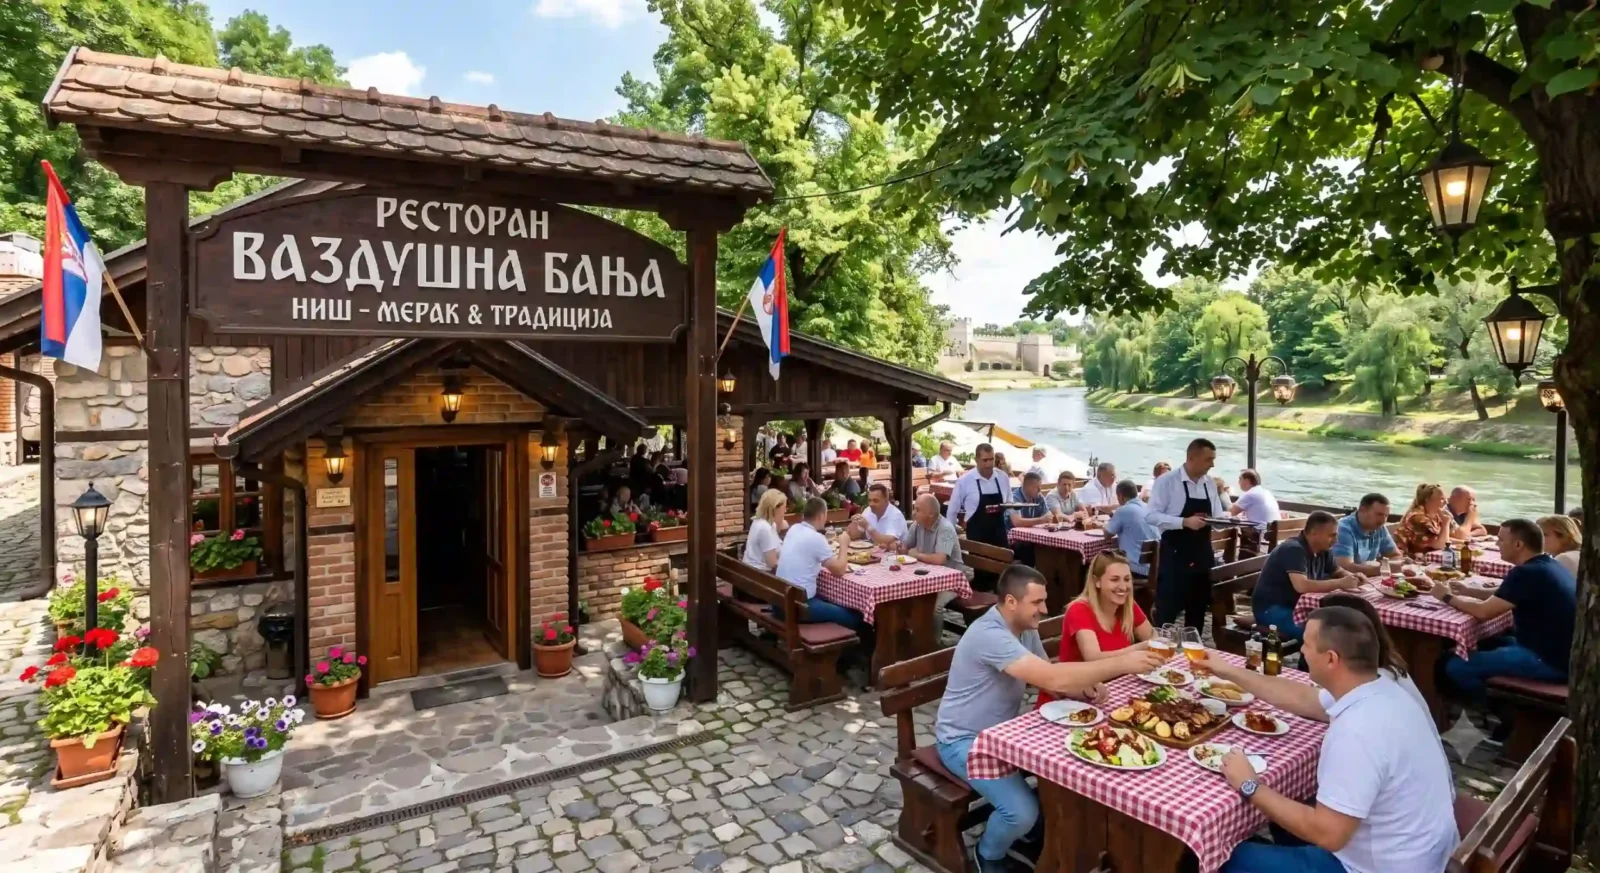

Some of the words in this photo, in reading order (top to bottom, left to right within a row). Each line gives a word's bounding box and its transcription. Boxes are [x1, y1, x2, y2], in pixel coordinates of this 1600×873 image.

[376, 197, 550, 240] РЕСТОРАН
[232, 231, 527, 293] ВАЗДУШНА
[544, 252, 666, 298] БАЊА
[292, 297, 352, 321] НИШ
[377, 300, 460, 325] МЕРАК
[467, 303, 483, 325] &
[490, 304, 613, 331] ТРАДИЦИЈА
